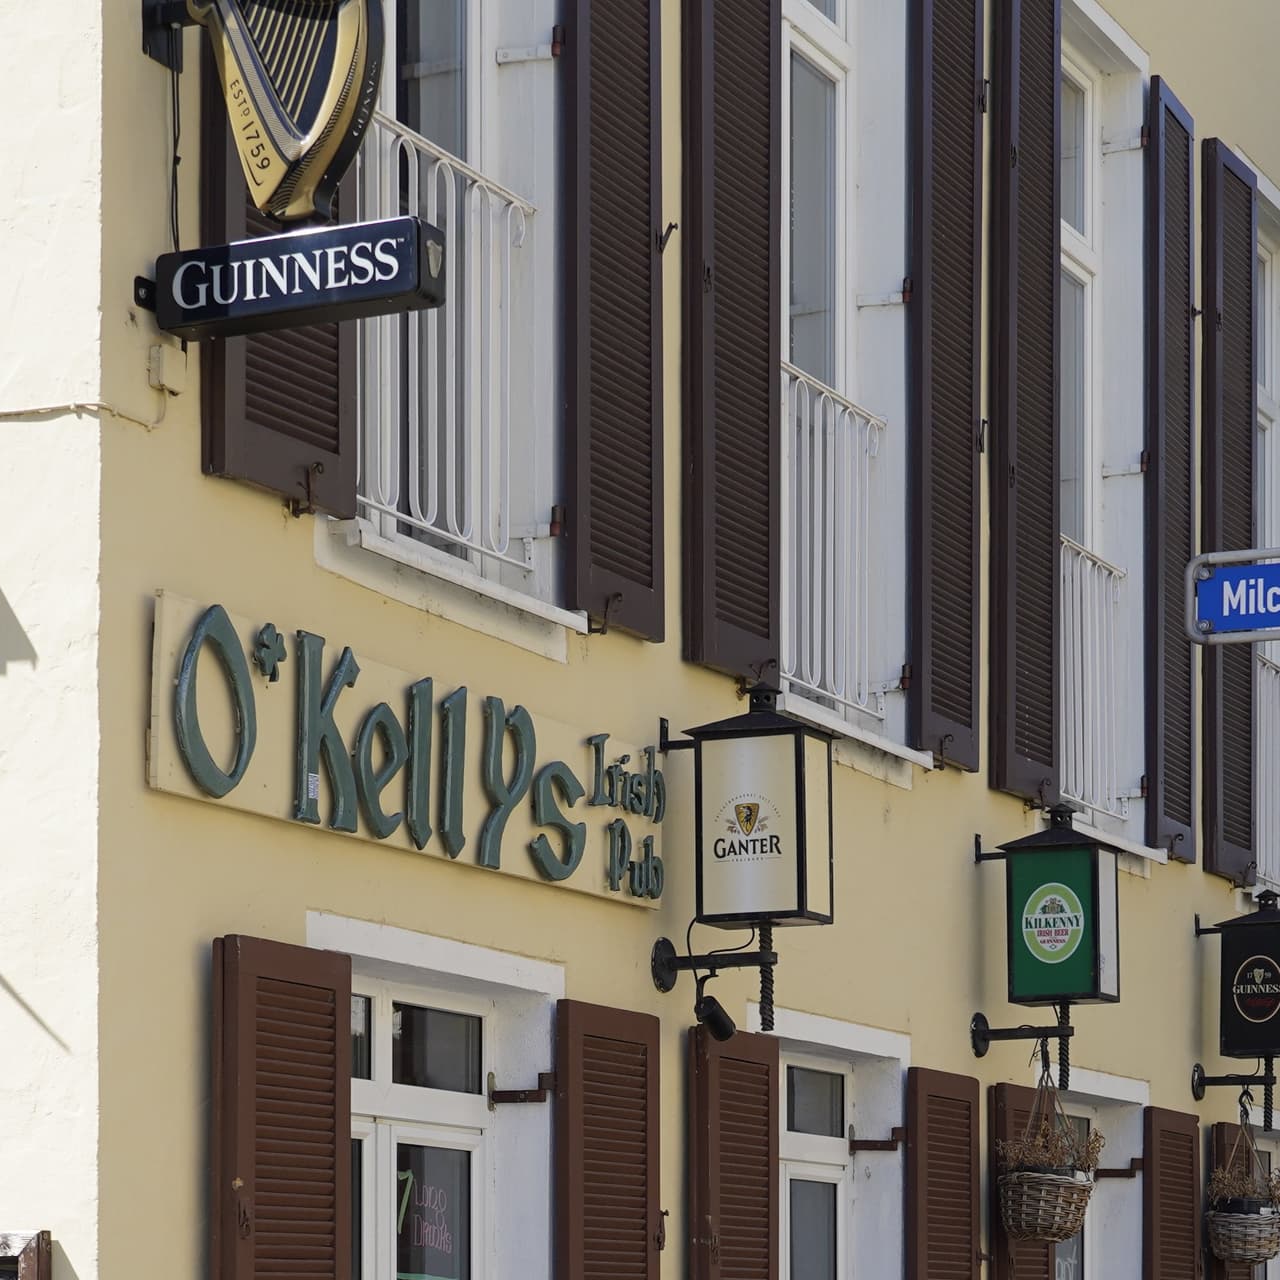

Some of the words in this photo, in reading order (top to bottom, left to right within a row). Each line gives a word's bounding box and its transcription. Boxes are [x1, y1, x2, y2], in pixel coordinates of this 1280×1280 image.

[242, 119, 270, 170] 1759
[587, 733, 665, 824] Irish
[609, 818, 664, 899] Pub
[714, 835, 782, 859] GANTER
[1025, 915, 1081, 929] KILKENNY
